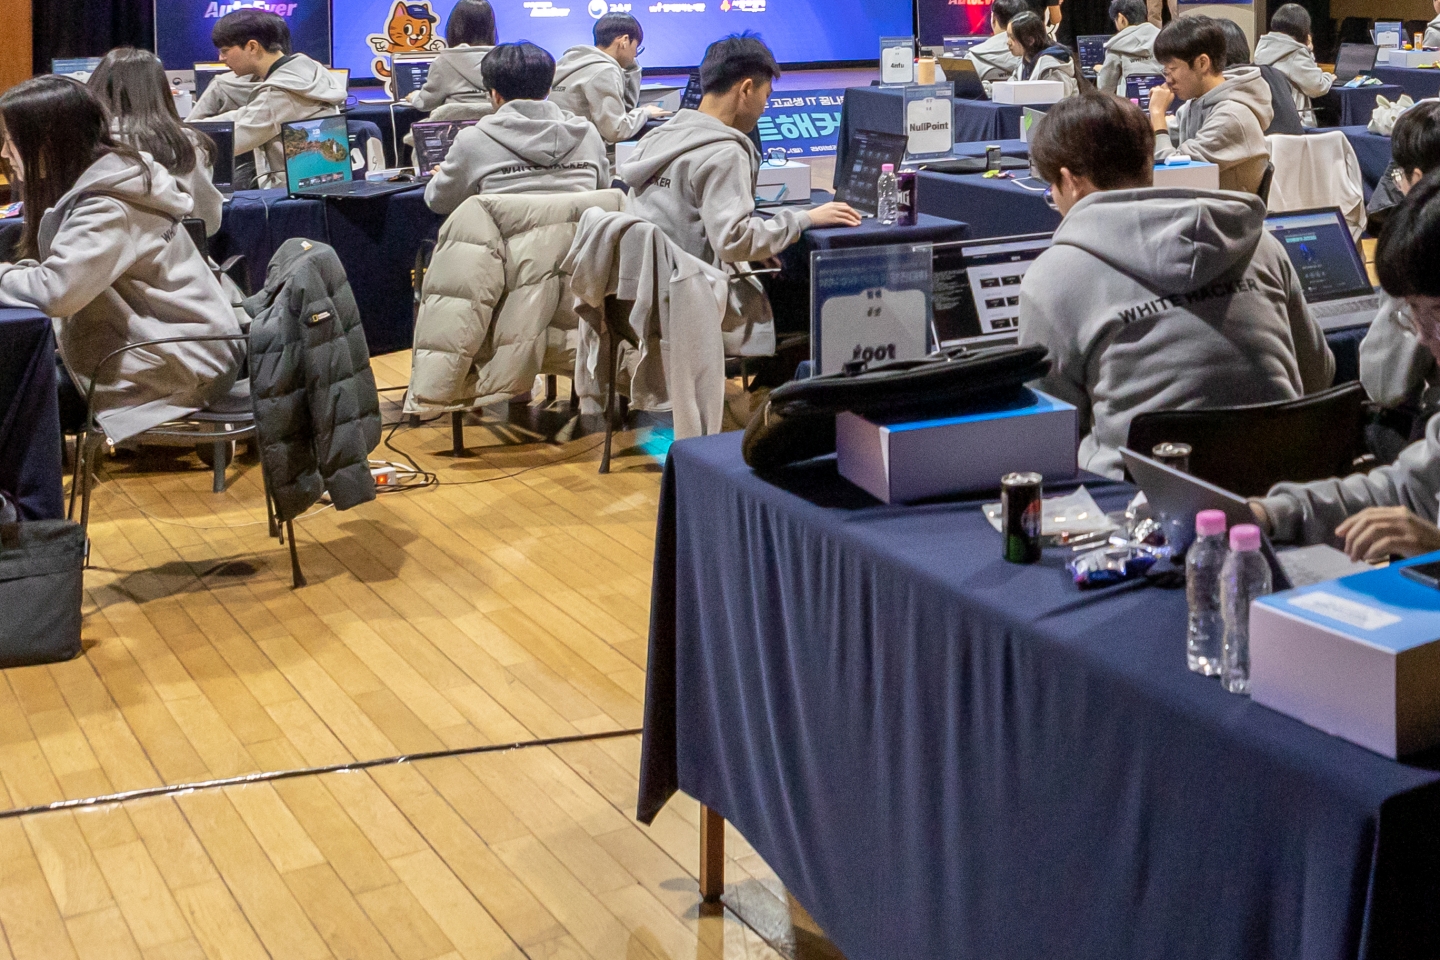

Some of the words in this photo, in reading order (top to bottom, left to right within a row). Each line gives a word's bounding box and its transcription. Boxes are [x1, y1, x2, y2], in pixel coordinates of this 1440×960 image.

[770, 97, 805, 108] 고교생
[805, 96, 817, 106] IT
[909, 122, 949, 132] NullPoint
[501, 164, 544, 175] WHITE
[545, 161, 588, 170] ACKER
[1118, 293, 1182, 324] WHITE
[1185, 278, 1259, 304] HACKER
